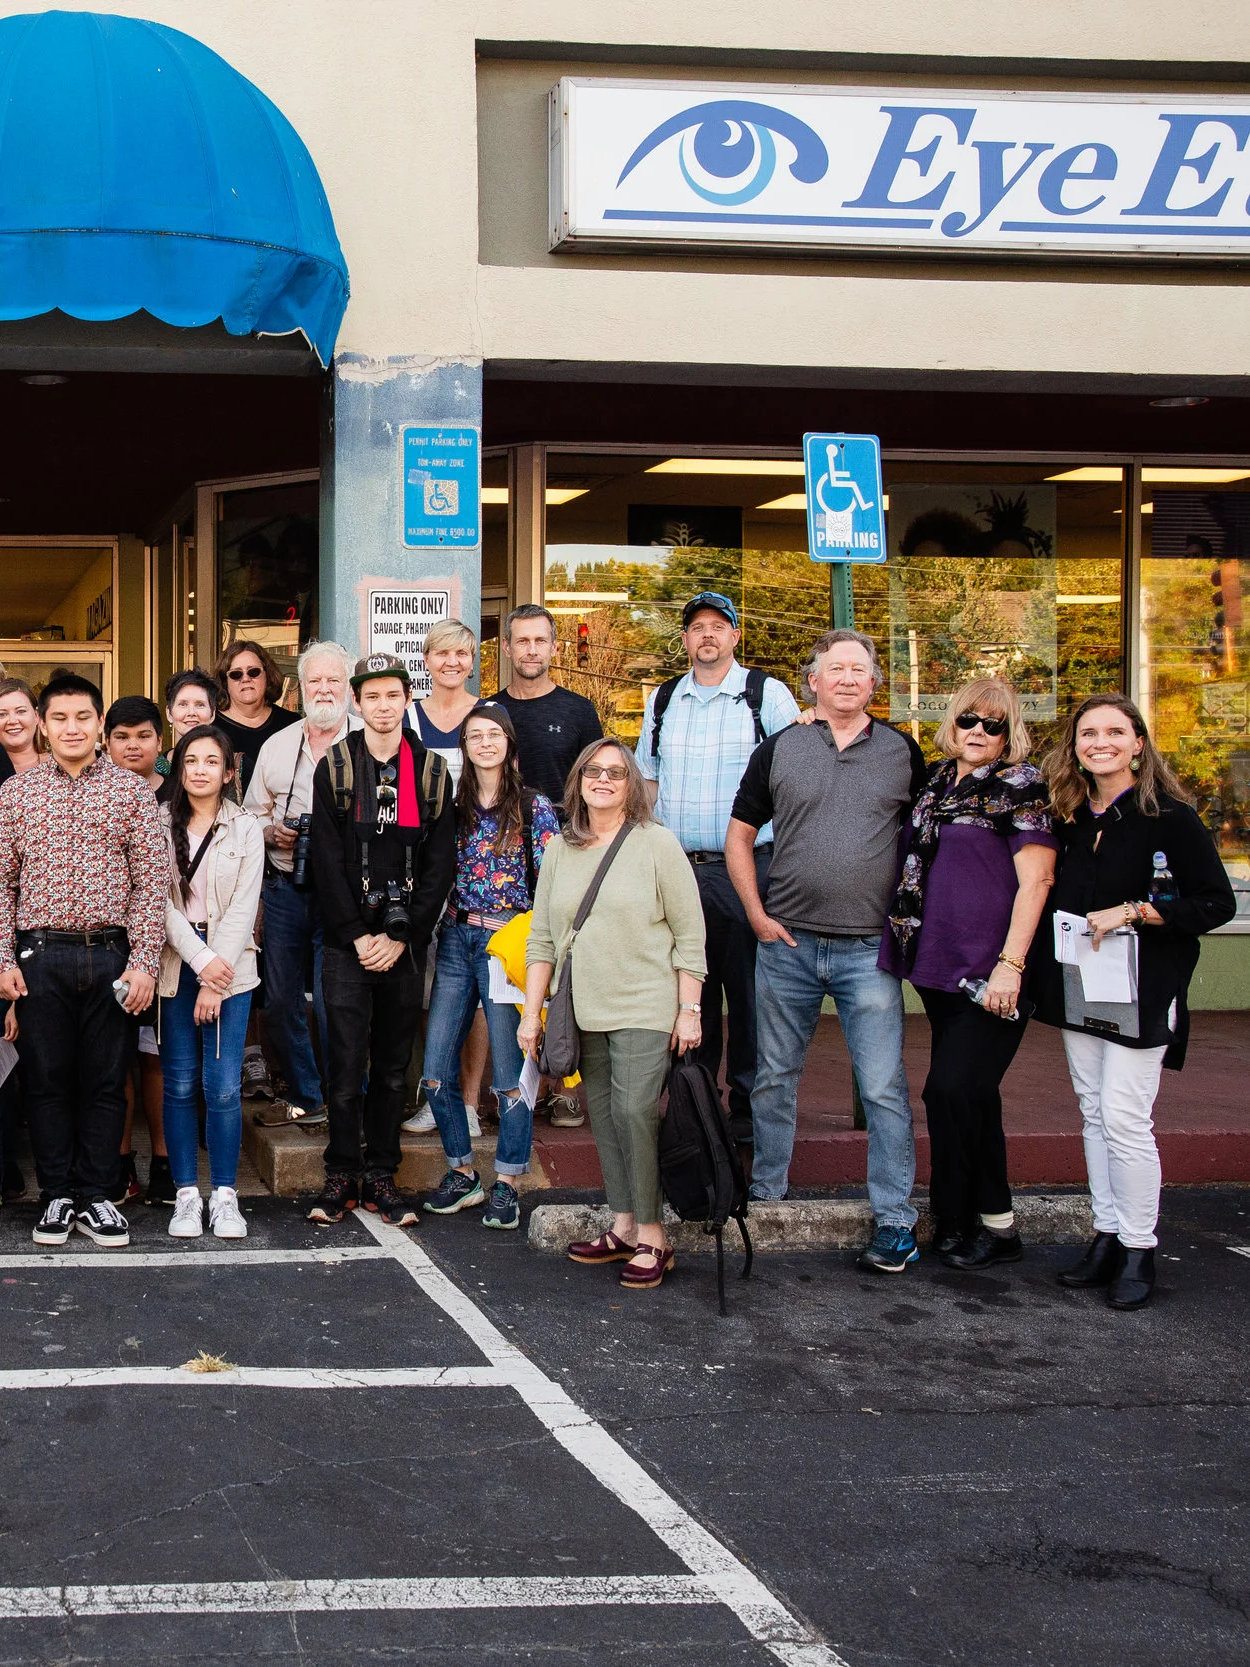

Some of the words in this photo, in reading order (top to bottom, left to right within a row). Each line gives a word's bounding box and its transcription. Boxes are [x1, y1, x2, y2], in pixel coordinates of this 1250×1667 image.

[841, 105, 1118, 238] Eye
[1120, 113, 1250, 217] E
[408, 437, 429, 446] PERMIT
[431, 437, 456, 447] PARKING
[458, 437, 473, 447] ONLY
[407, 527, 434, 536] MAXIMUM
[435, 527, 448, 536] FINE
[374, 596, 419, 615] PARKING
[420, 596, 445, 615] ONLY
[405, 622, 434, 635] PHARM
[408, 659, 430, 672] CENT
